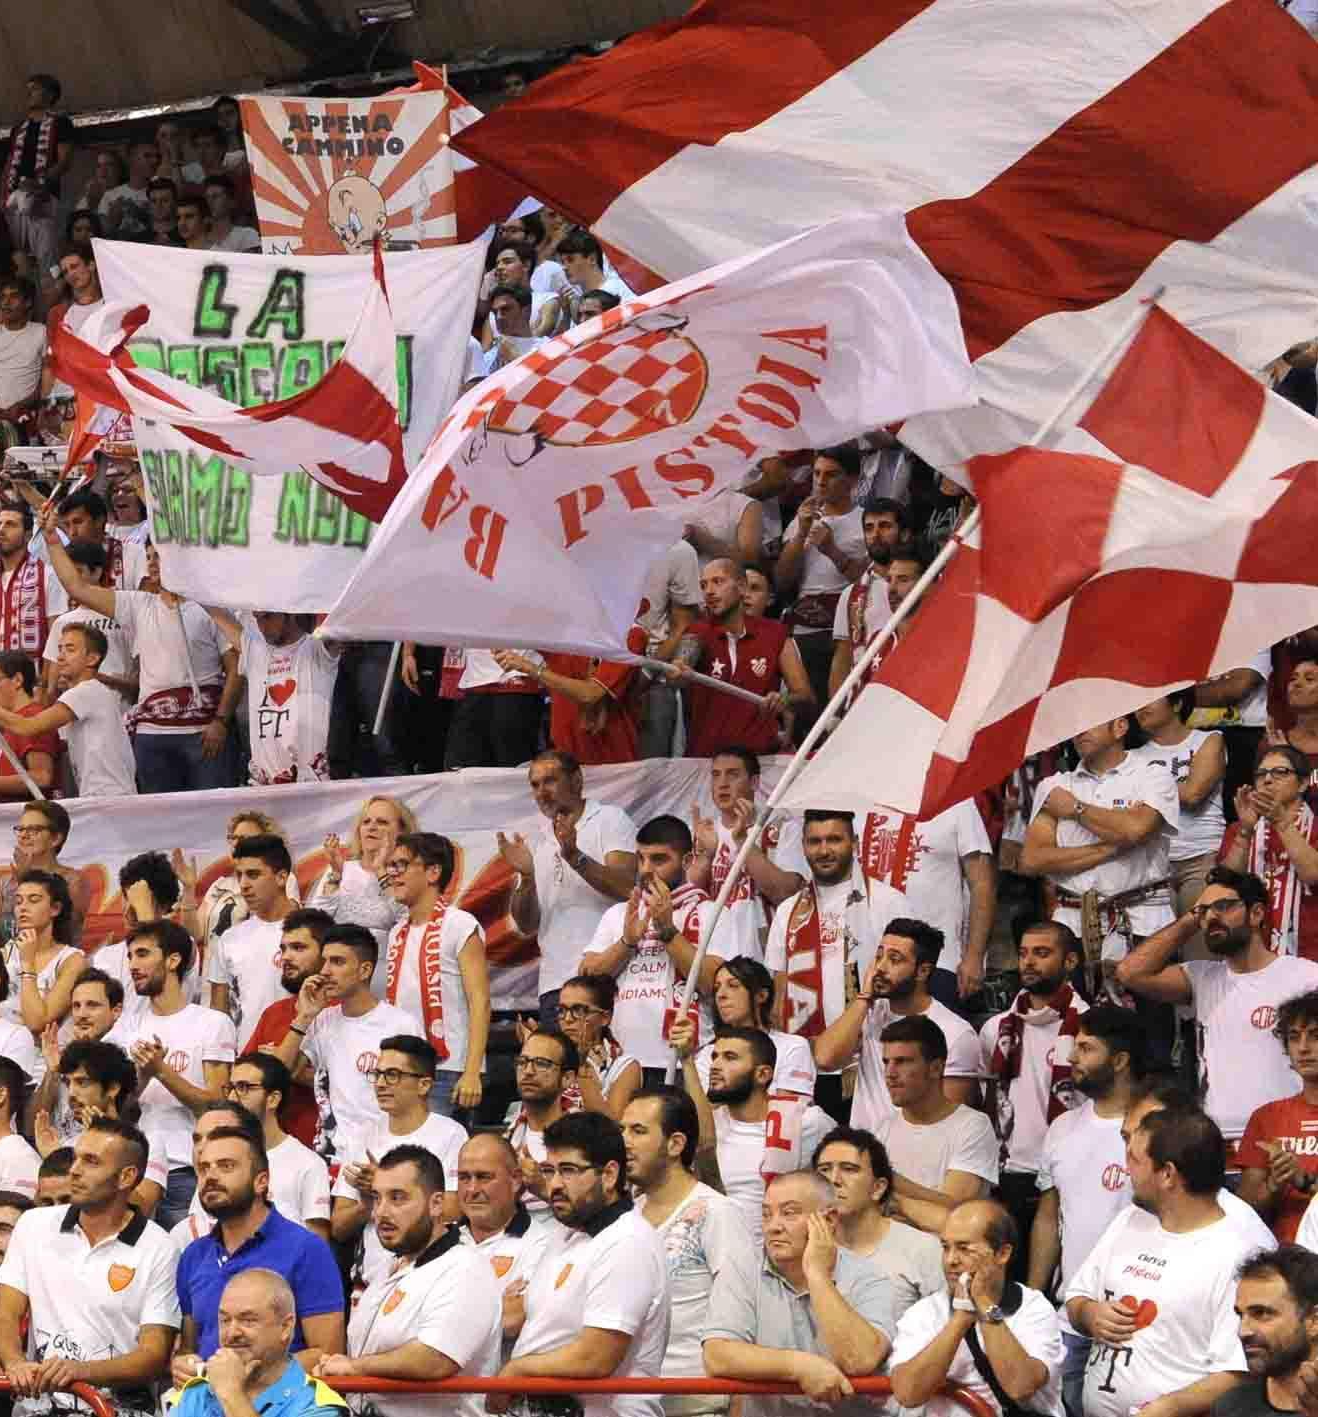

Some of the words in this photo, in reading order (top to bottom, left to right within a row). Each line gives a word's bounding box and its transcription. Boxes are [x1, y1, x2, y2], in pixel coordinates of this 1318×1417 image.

[193, 262, 306, 340] LA
[554, 324, 828, 551] PISTOIA
[629, 960, 667, 975] CALM
